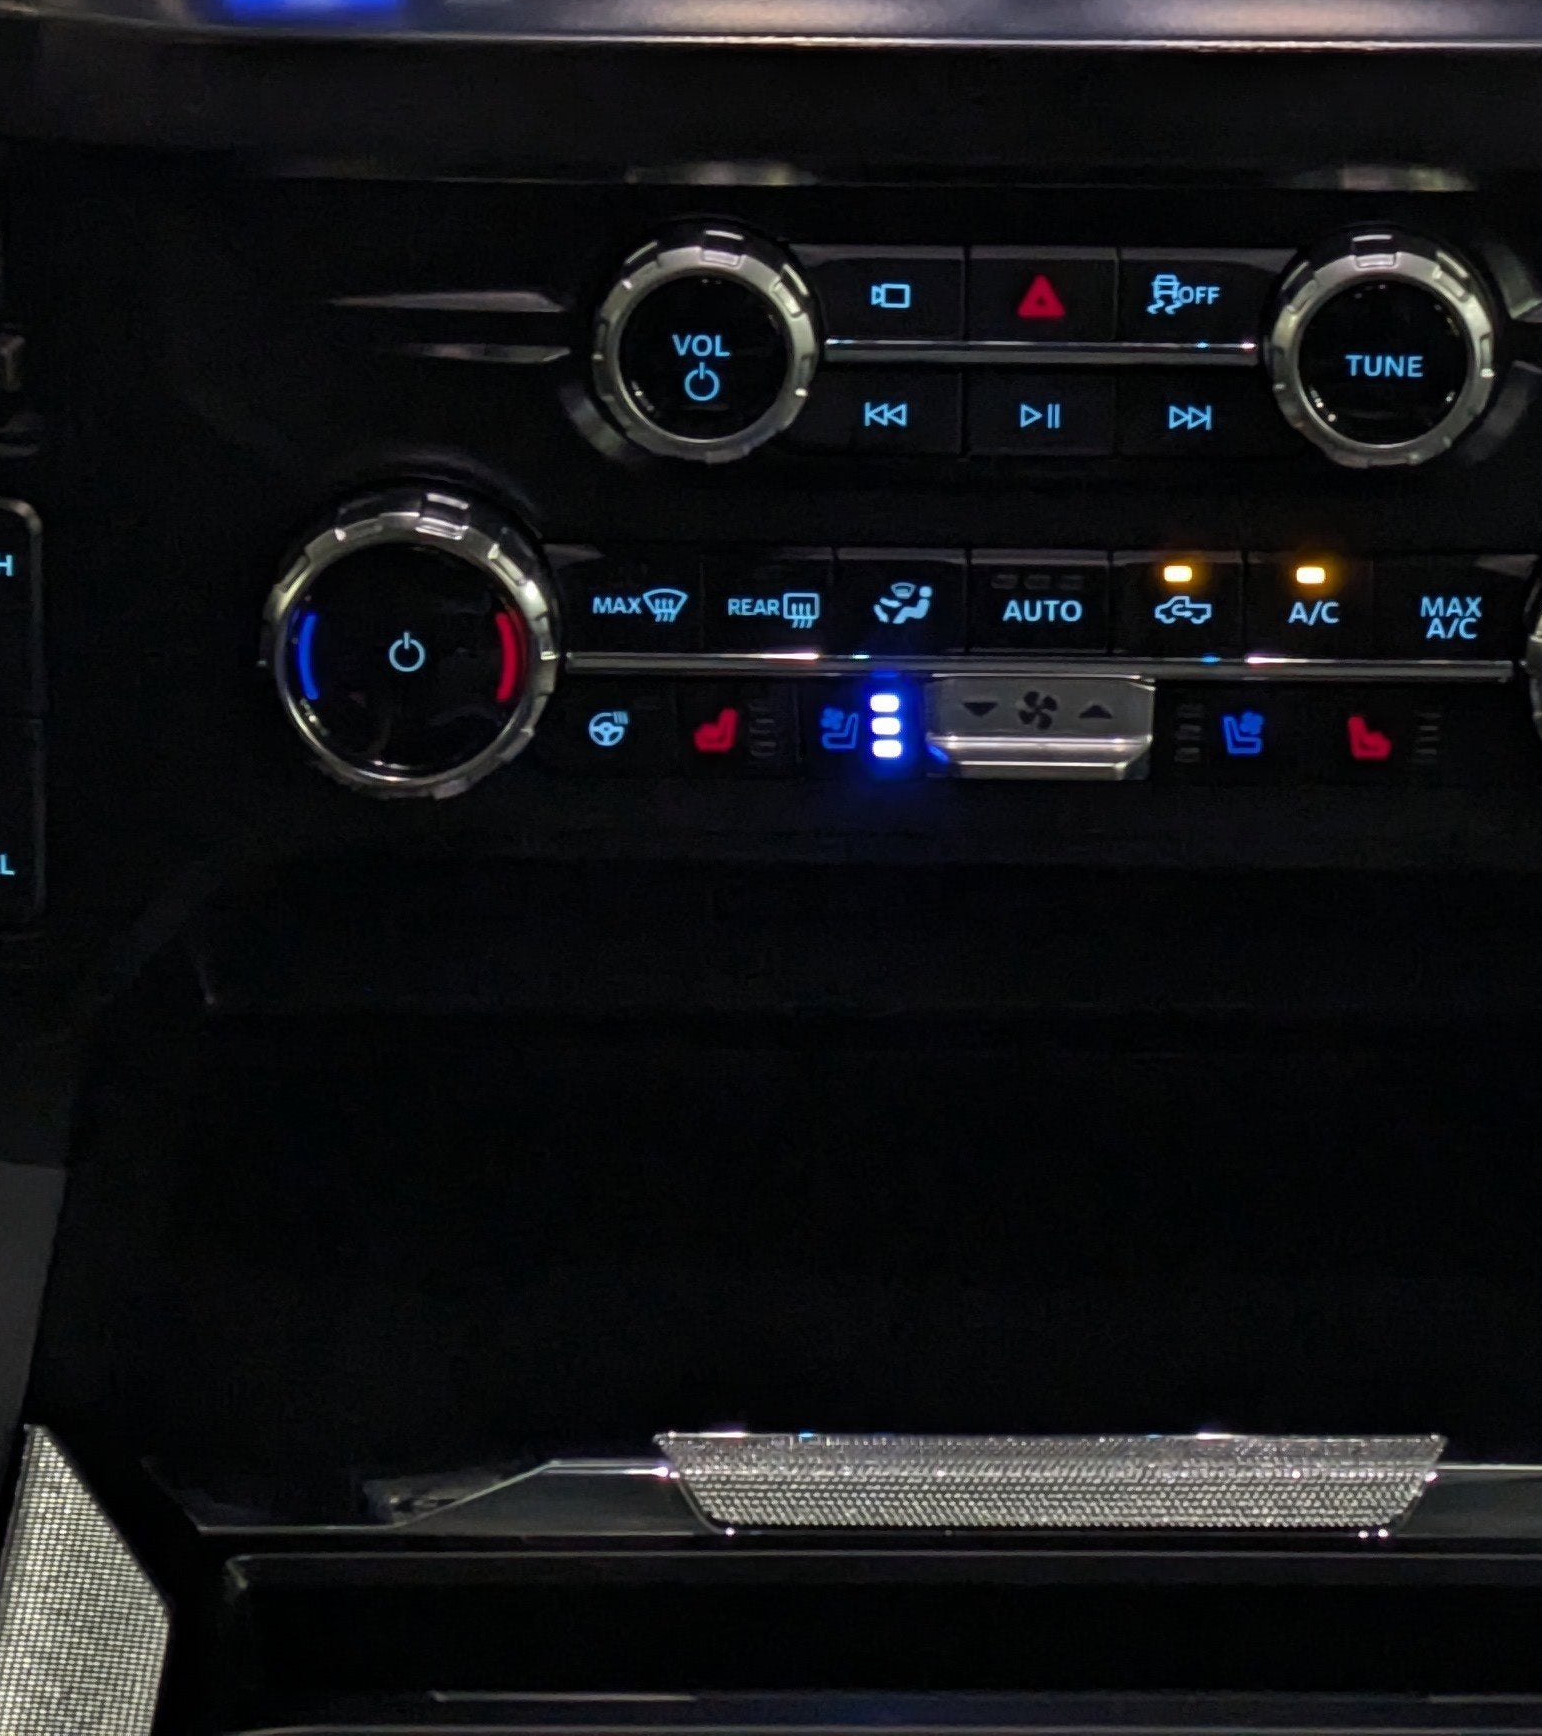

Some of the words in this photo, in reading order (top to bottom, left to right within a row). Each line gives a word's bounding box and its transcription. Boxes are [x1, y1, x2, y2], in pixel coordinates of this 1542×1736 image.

[1178, 285, 1221, 307] OFF
[671, 334, 731, 358] VOL
[1345, 354, 1424, 378] TUNE
[592, 596, 641, 616] MAX
[727, 598, 780, 616] REAR
[1002, 599, 1083, 622] AUTO
[1287, 600, 1339, 626] A/C
[1420, 596, 1482, 618] MAX
[1425, 618, 1477, 640] A/C
